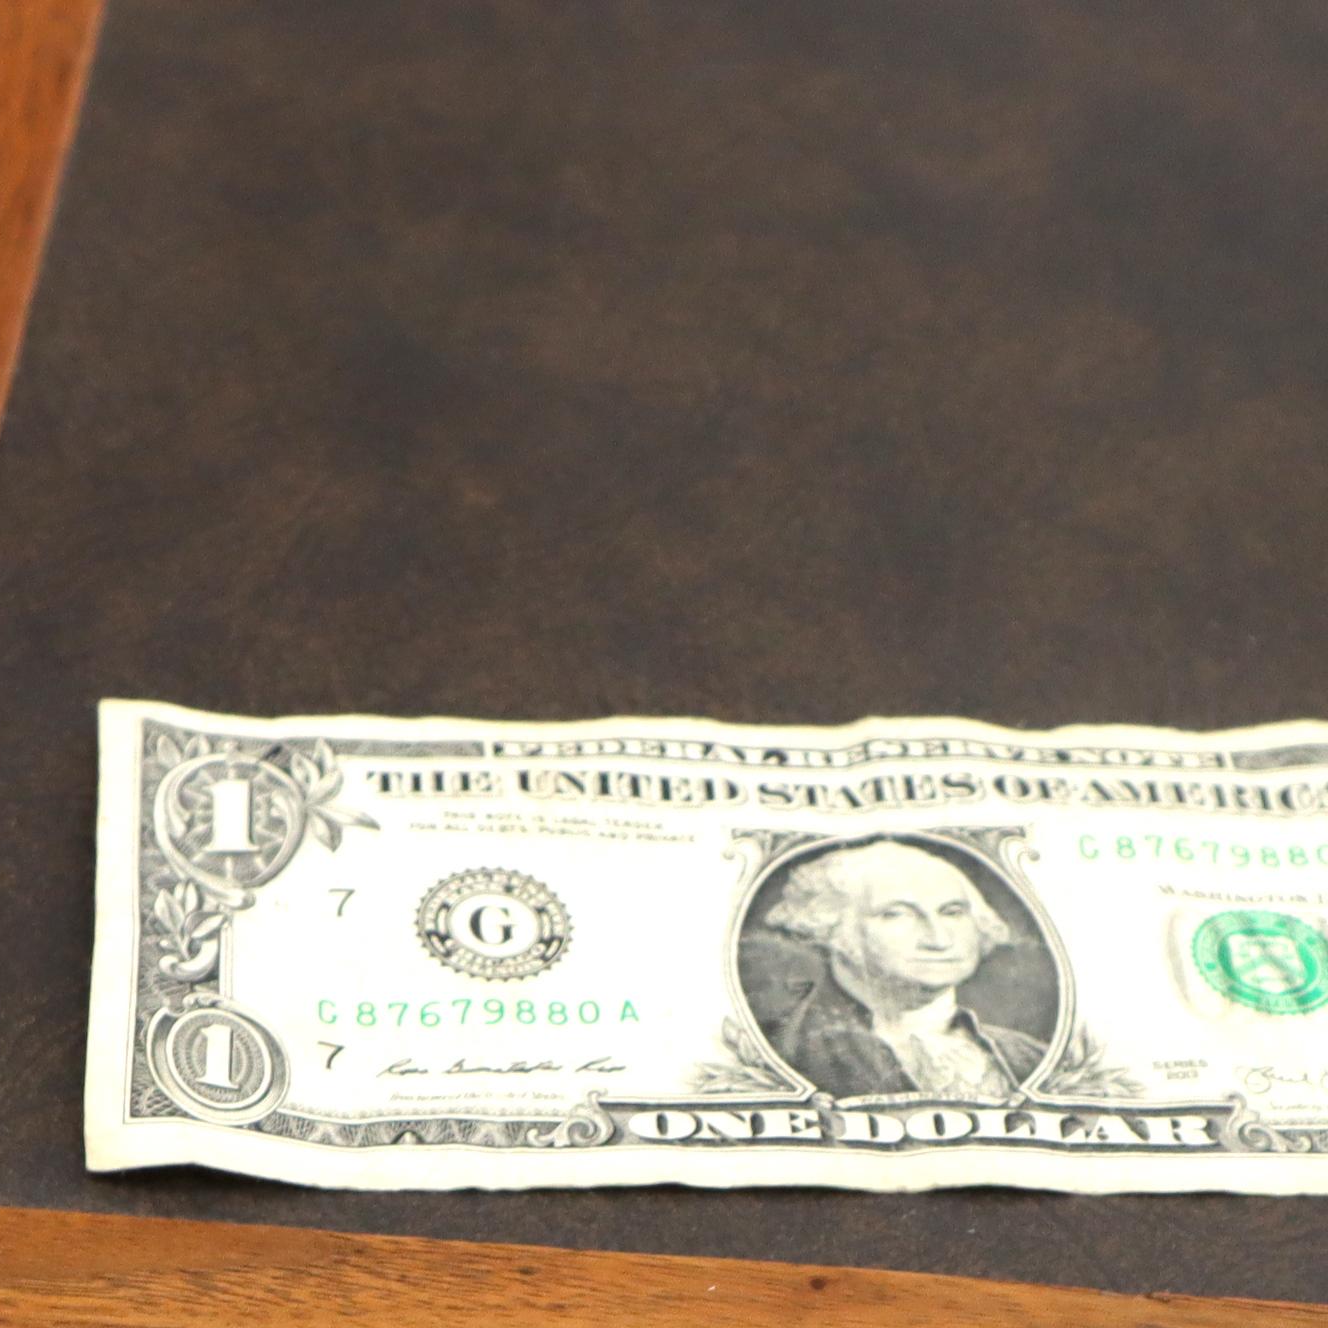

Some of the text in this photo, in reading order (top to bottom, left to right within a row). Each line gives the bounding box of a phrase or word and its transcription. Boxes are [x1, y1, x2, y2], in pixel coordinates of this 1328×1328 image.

[366, 769, 502, 798] THE
[517, 769, 748, 808] UNITED
[758, 773, 985, 813] STATES
[993, 774, 1070, 803] OF
[203, 779, 261, 853] 1
[329, 888, 355, 917] 7
[469, 905, 516, 946] G
[317, 999, 640, 1028] G 87679880 A
[196, 1023, 240, 1089] 1
[317, 1040, 345, 1070] 7
[628, 1109, 1218, 1145] ONE DOLLAR
